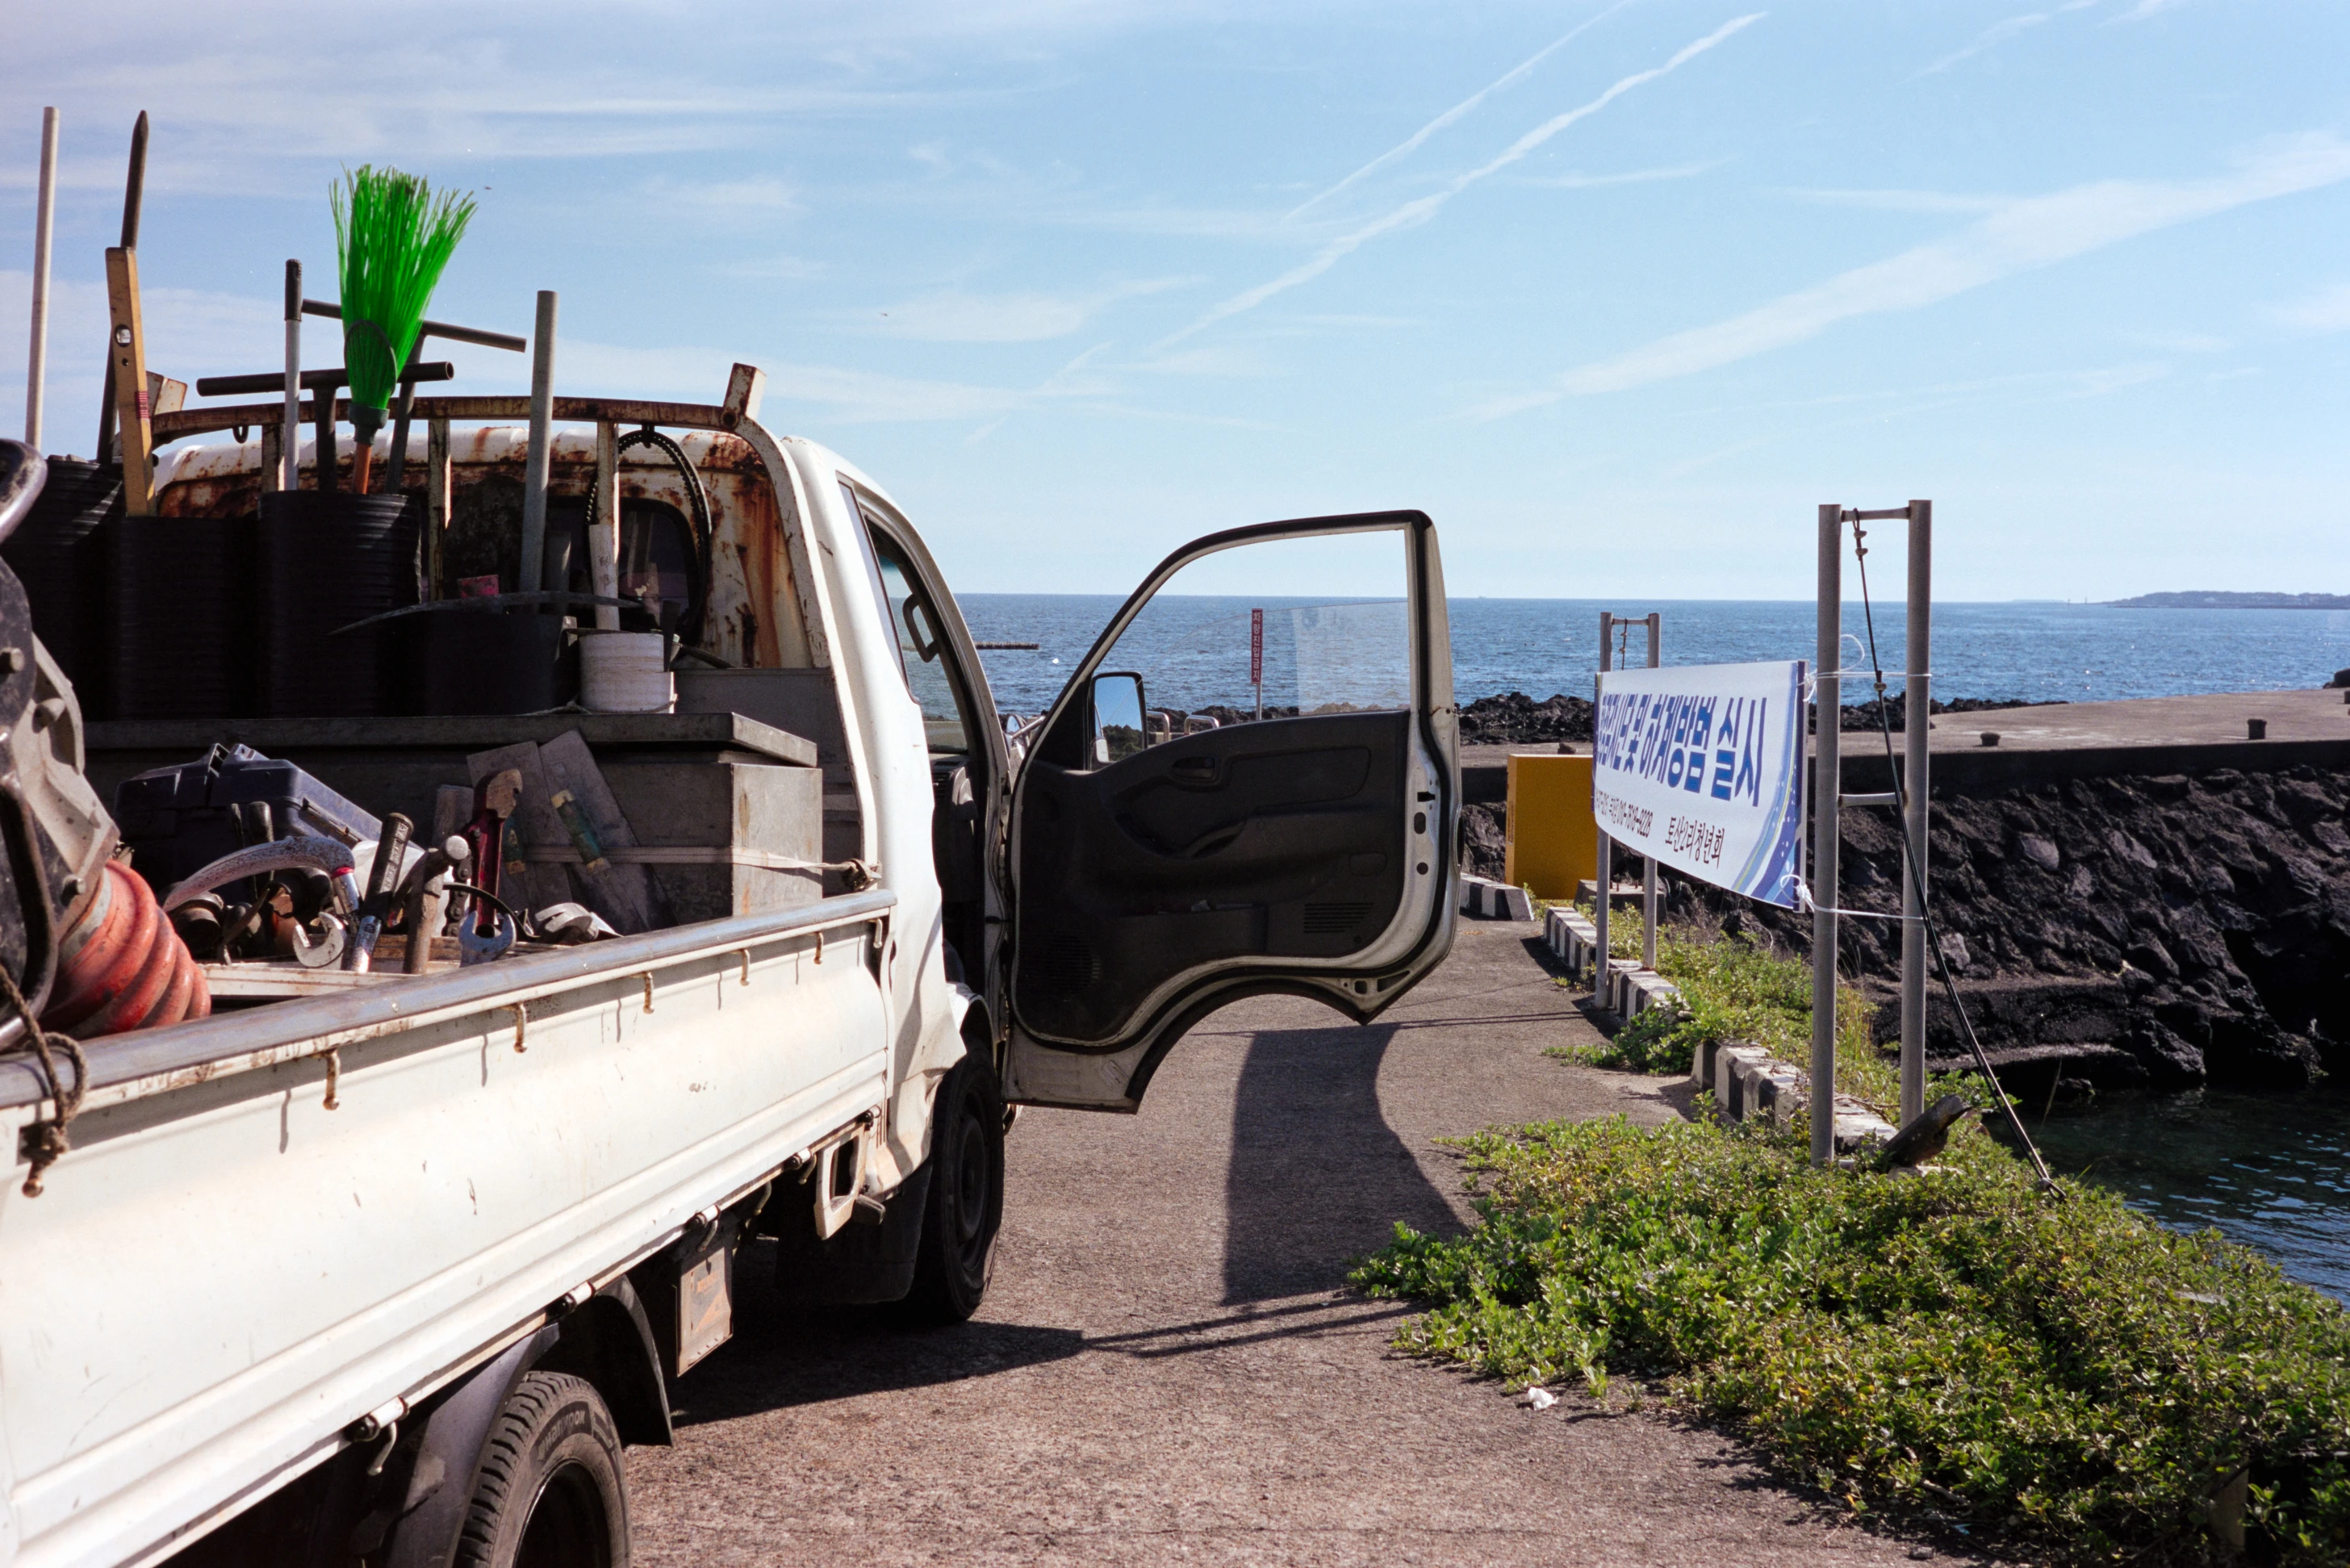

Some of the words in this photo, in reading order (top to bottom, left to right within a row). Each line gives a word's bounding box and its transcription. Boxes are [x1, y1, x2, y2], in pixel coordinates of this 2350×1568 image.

[1640, 693, 1717, 793] 하계방범
[1711, 696, 1767, 807] 실시
[1665, 816, 1725, 869] 토산2리청년회
